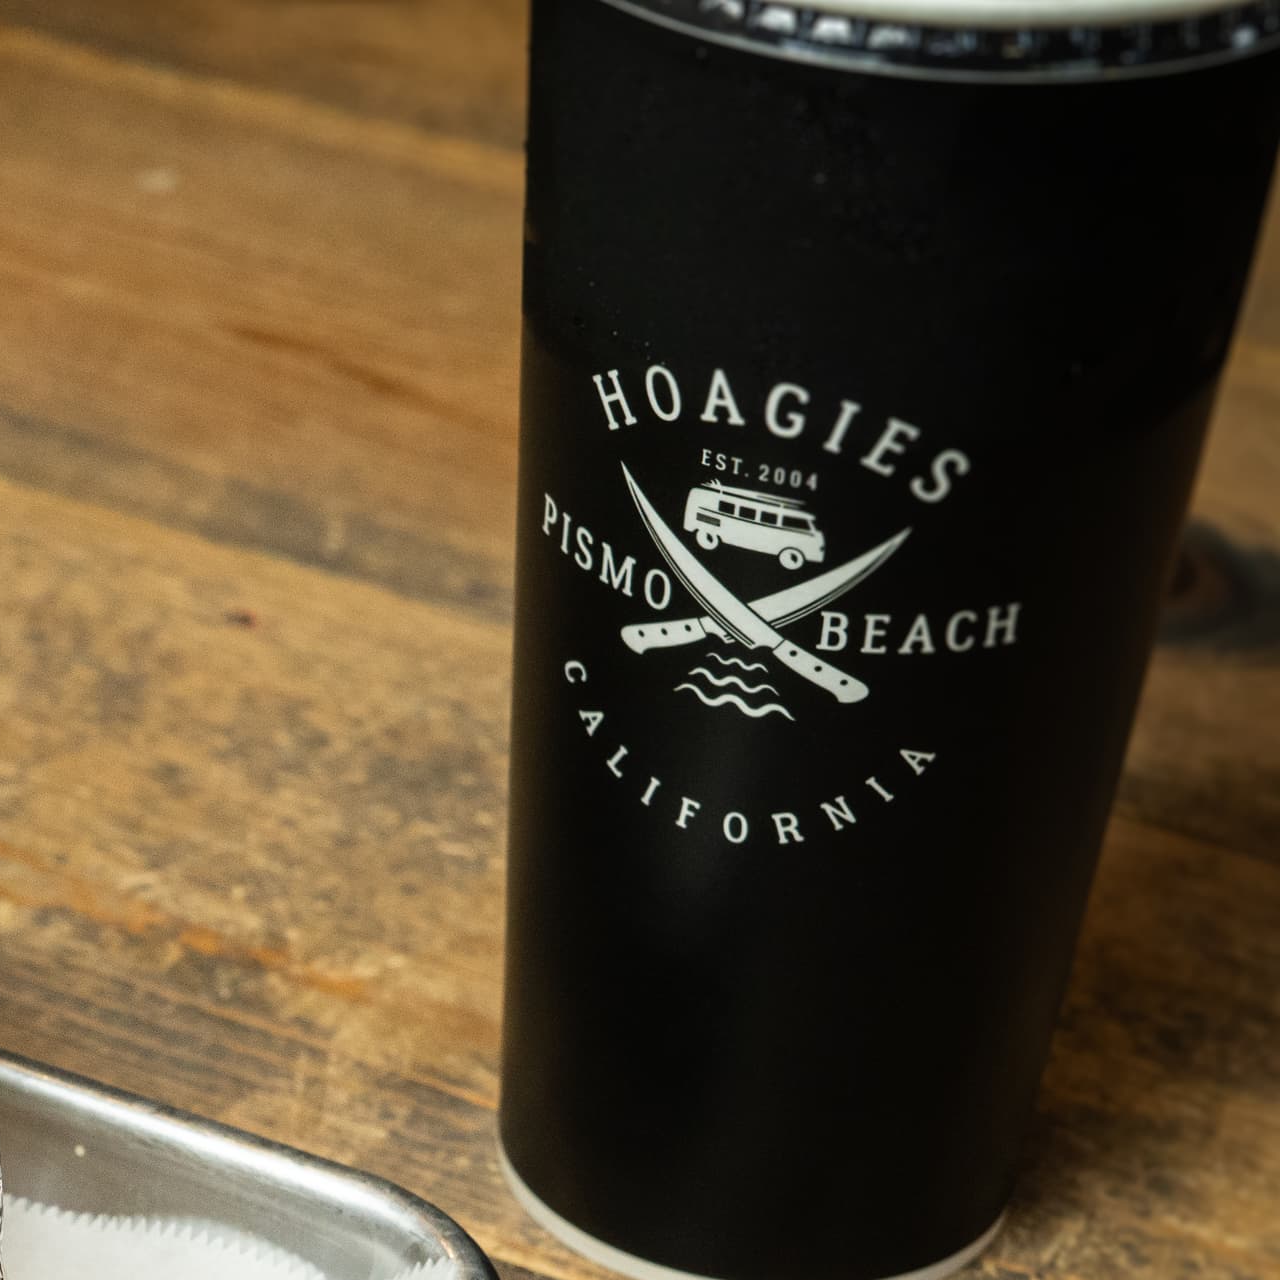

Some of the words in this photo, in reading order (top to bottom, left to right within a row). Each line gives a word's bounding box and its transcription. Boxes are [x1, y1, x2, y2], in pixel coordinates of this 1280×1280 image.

[593, 365, 970, 502] HOAGIES
[702, 449, 749, 477] EST.
[758, 464, 819, 491] 2004
[541, 493, 672, 610] PISMO
[816, 603, 1021, 655] BEACH
[564, 660, 936, 844] CALIFORNIA
